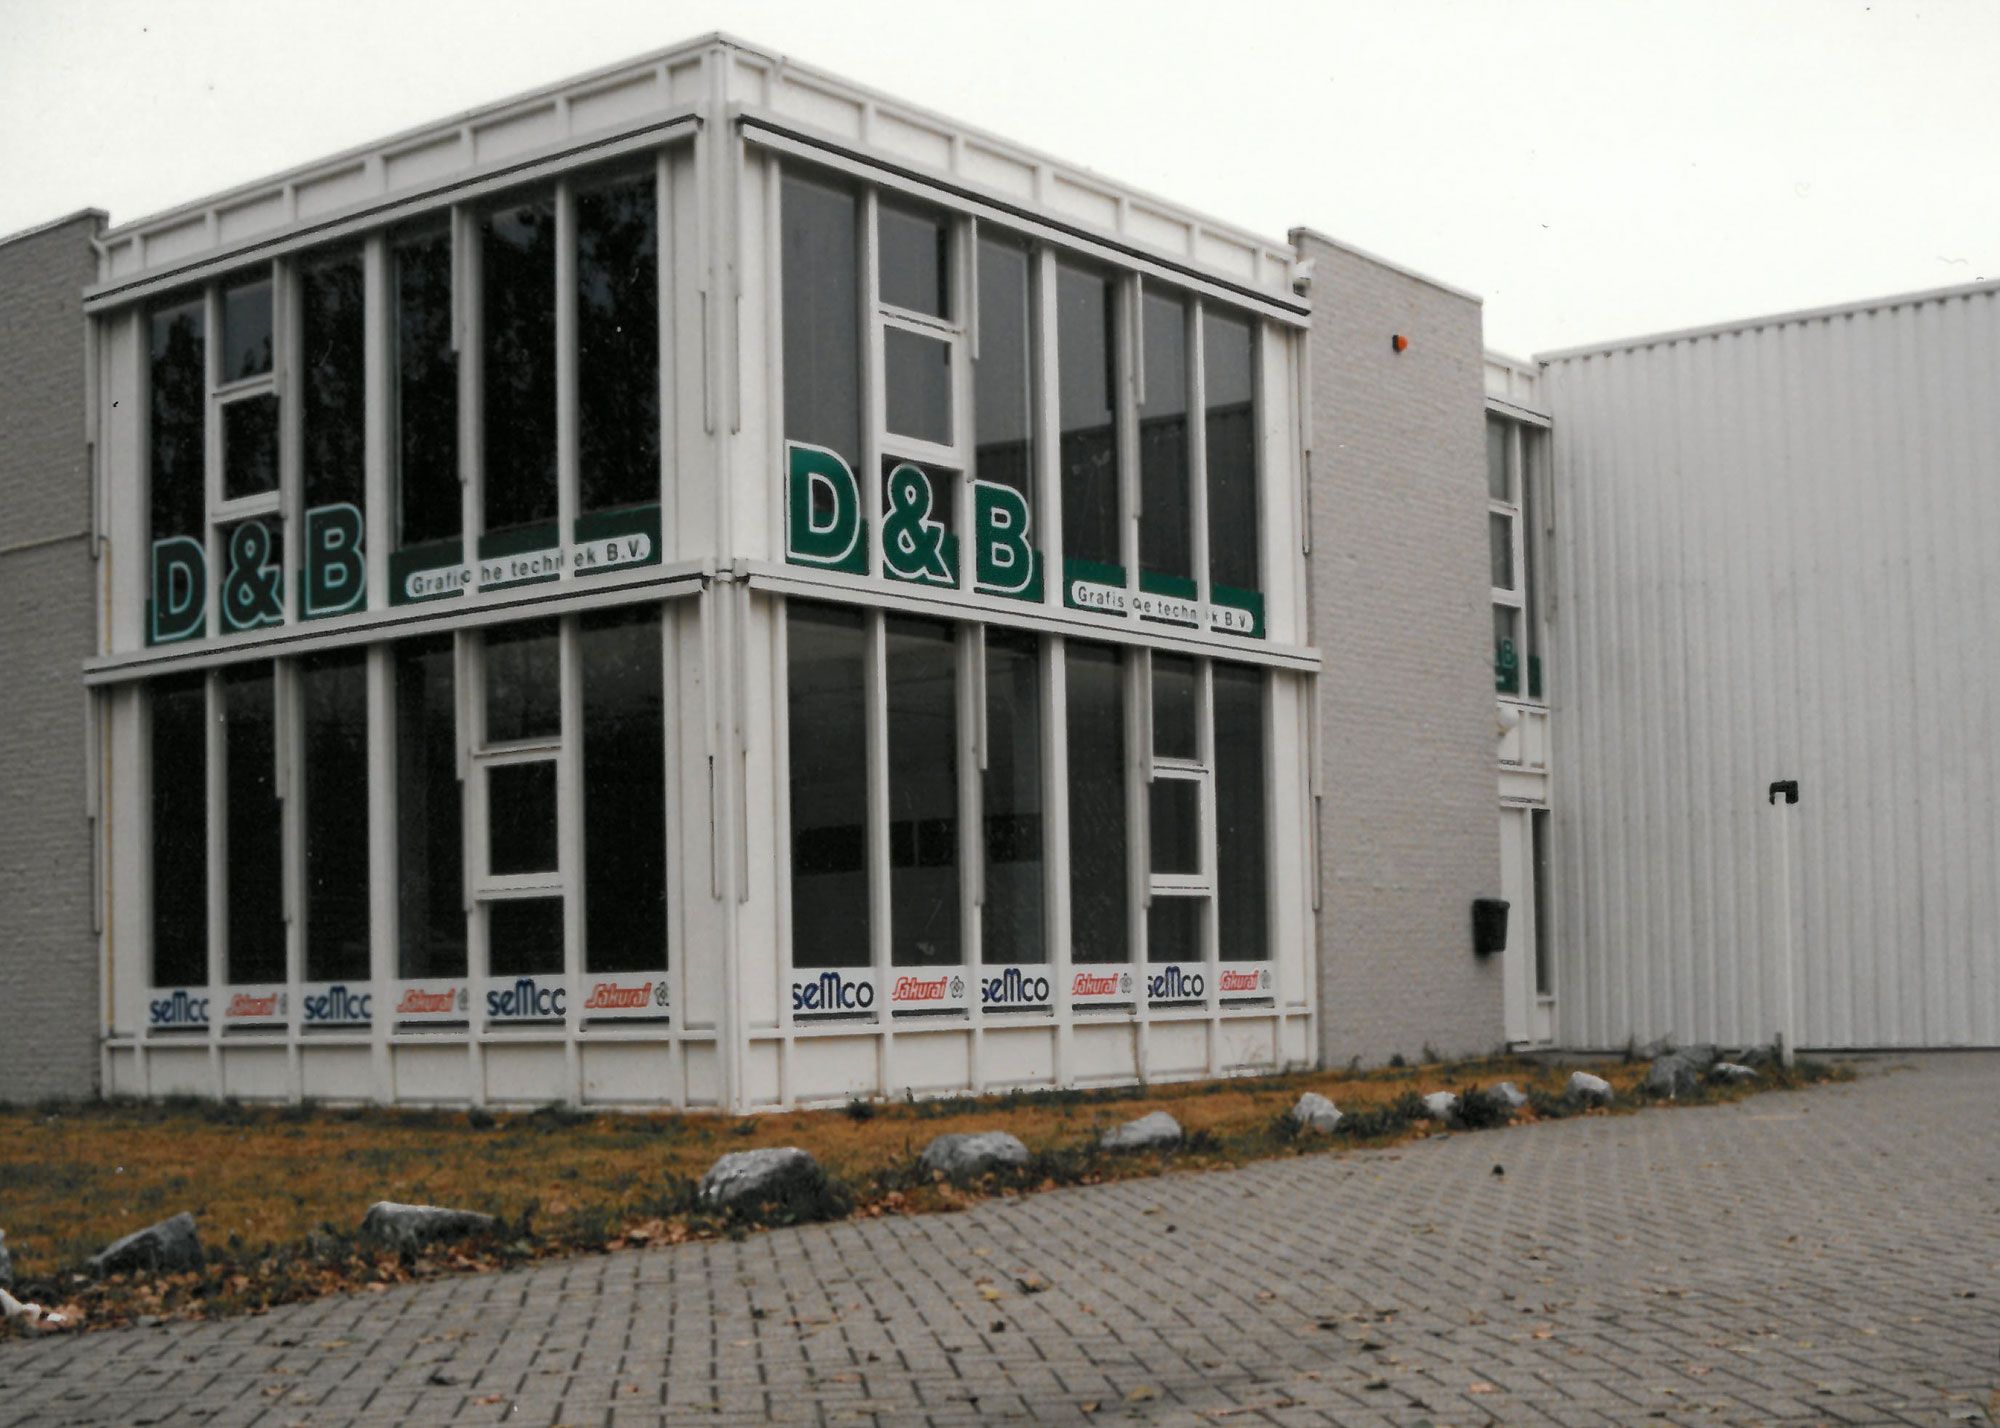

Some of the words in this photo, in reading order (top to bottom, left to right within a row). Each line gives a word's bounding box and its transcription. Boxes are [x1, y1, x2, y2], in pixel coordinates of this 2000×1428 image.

[412, 566, 502, 594] Grafiche
[892, 976, 949, 1001] Sakurai
[1072, 973, 1119, 996] Sakurai
